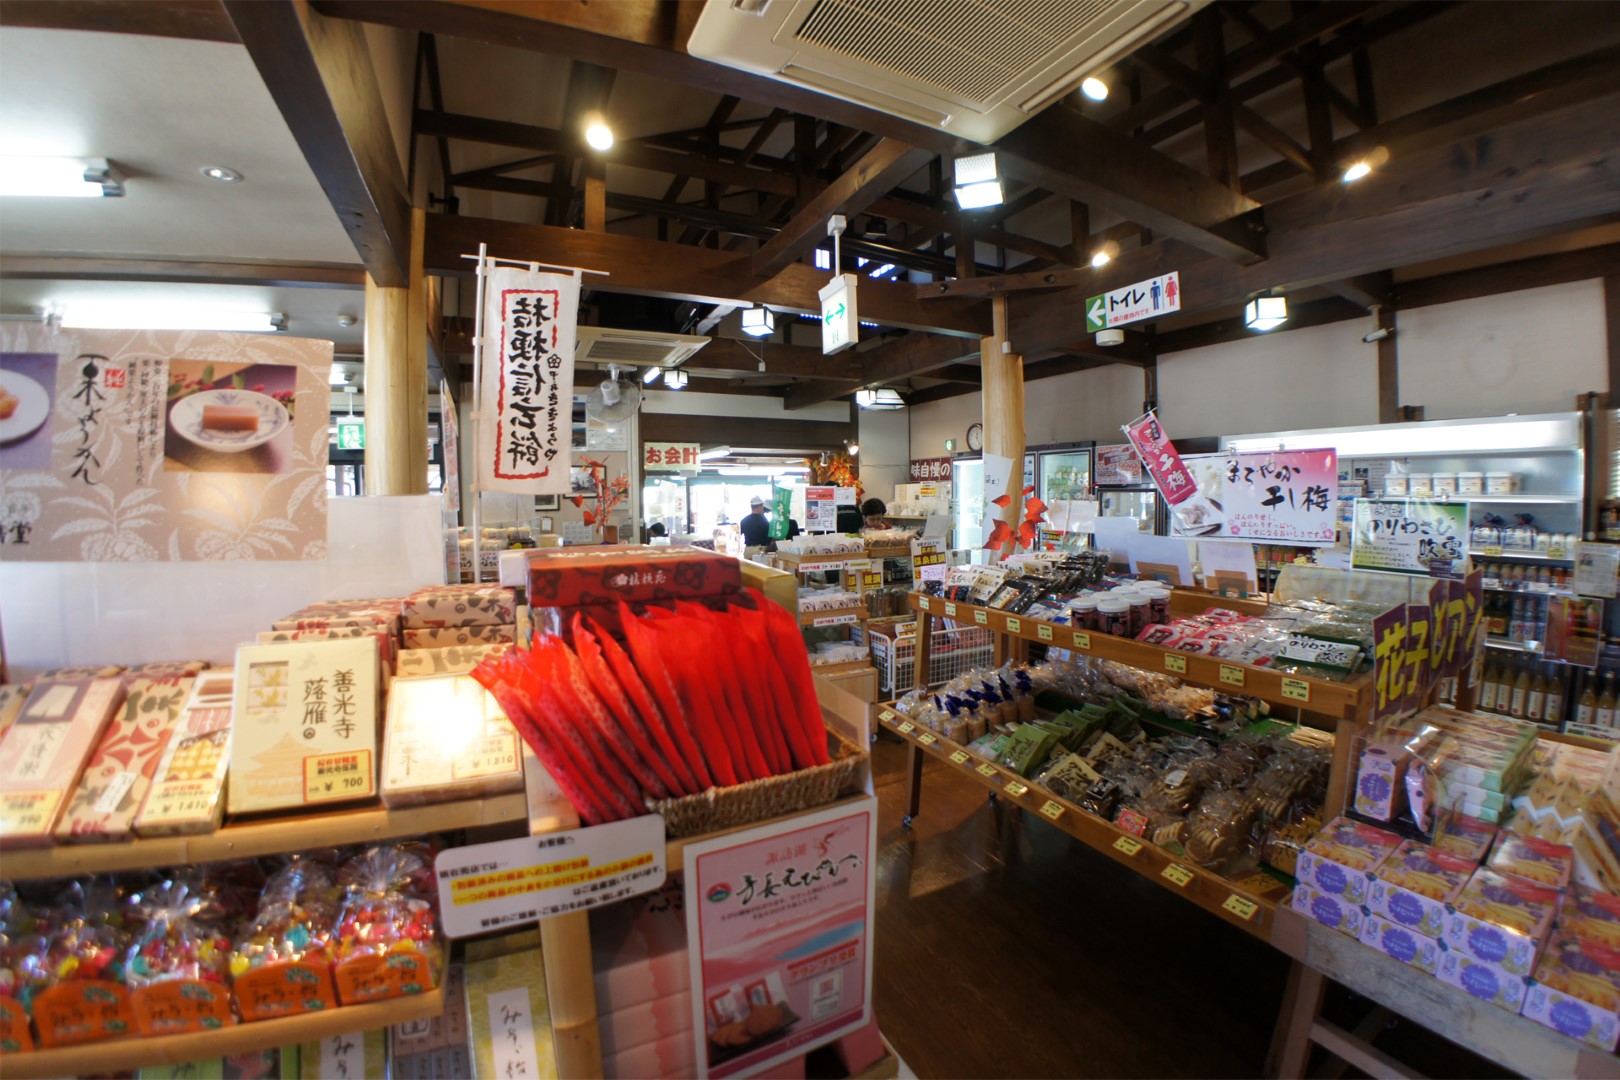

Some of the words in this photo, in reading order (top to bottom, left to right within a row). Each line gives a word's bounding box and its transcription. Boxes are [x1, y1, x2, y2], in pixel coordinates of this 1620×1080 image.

[1110, 289, 1146, 312] トイレ
[646, 447, 699, 465] お会計
[910, 462, 951, 479] 味自慢の
[1261, 485, 1331, 513] 干し梅
[1367, 517, 1455, 536] のりわさび
[303, 677, 329, 725] 落雁
[333, 668, 356, 739] 善光寺
[343, 777, 363, 790] 700
